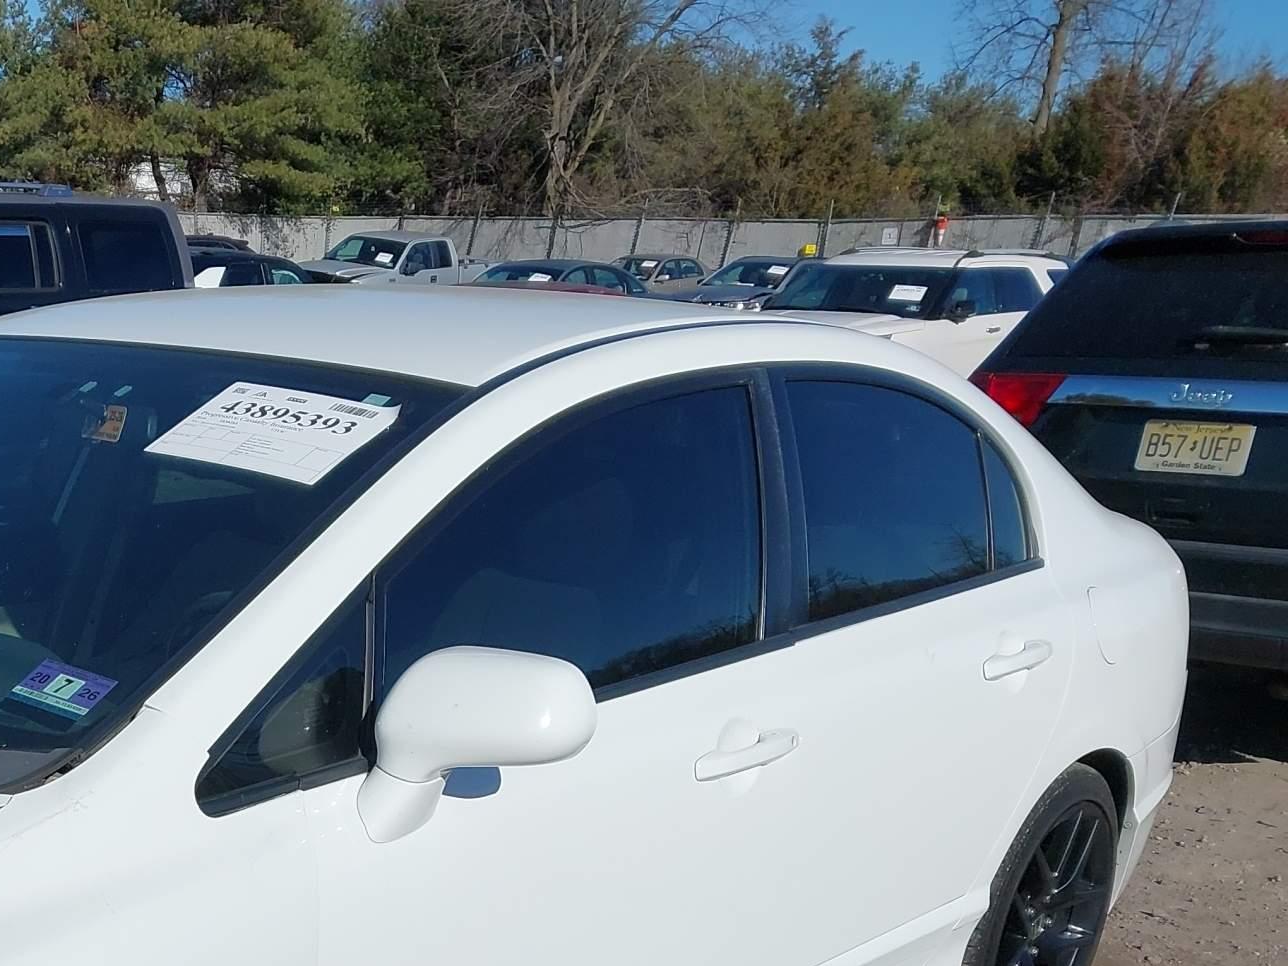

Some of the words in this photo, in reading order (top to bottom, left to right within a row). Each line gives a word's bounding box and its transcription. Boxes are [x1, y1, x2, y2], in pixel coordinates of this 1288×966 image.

[1170, 383, 1234, 407] Jeep
[220, 400, 358, 435] 43895393
[1145, 433, 1189, 458] B57
[1199, 435, 1242, 462] UEP
[1162, 460, 1191, 470] Garden
[1193, 462, 1216, 470] State
[30, 671, 51, 685] 20
[53, 678, 75, 694] 7
[77, 688, 101, 701] 26
